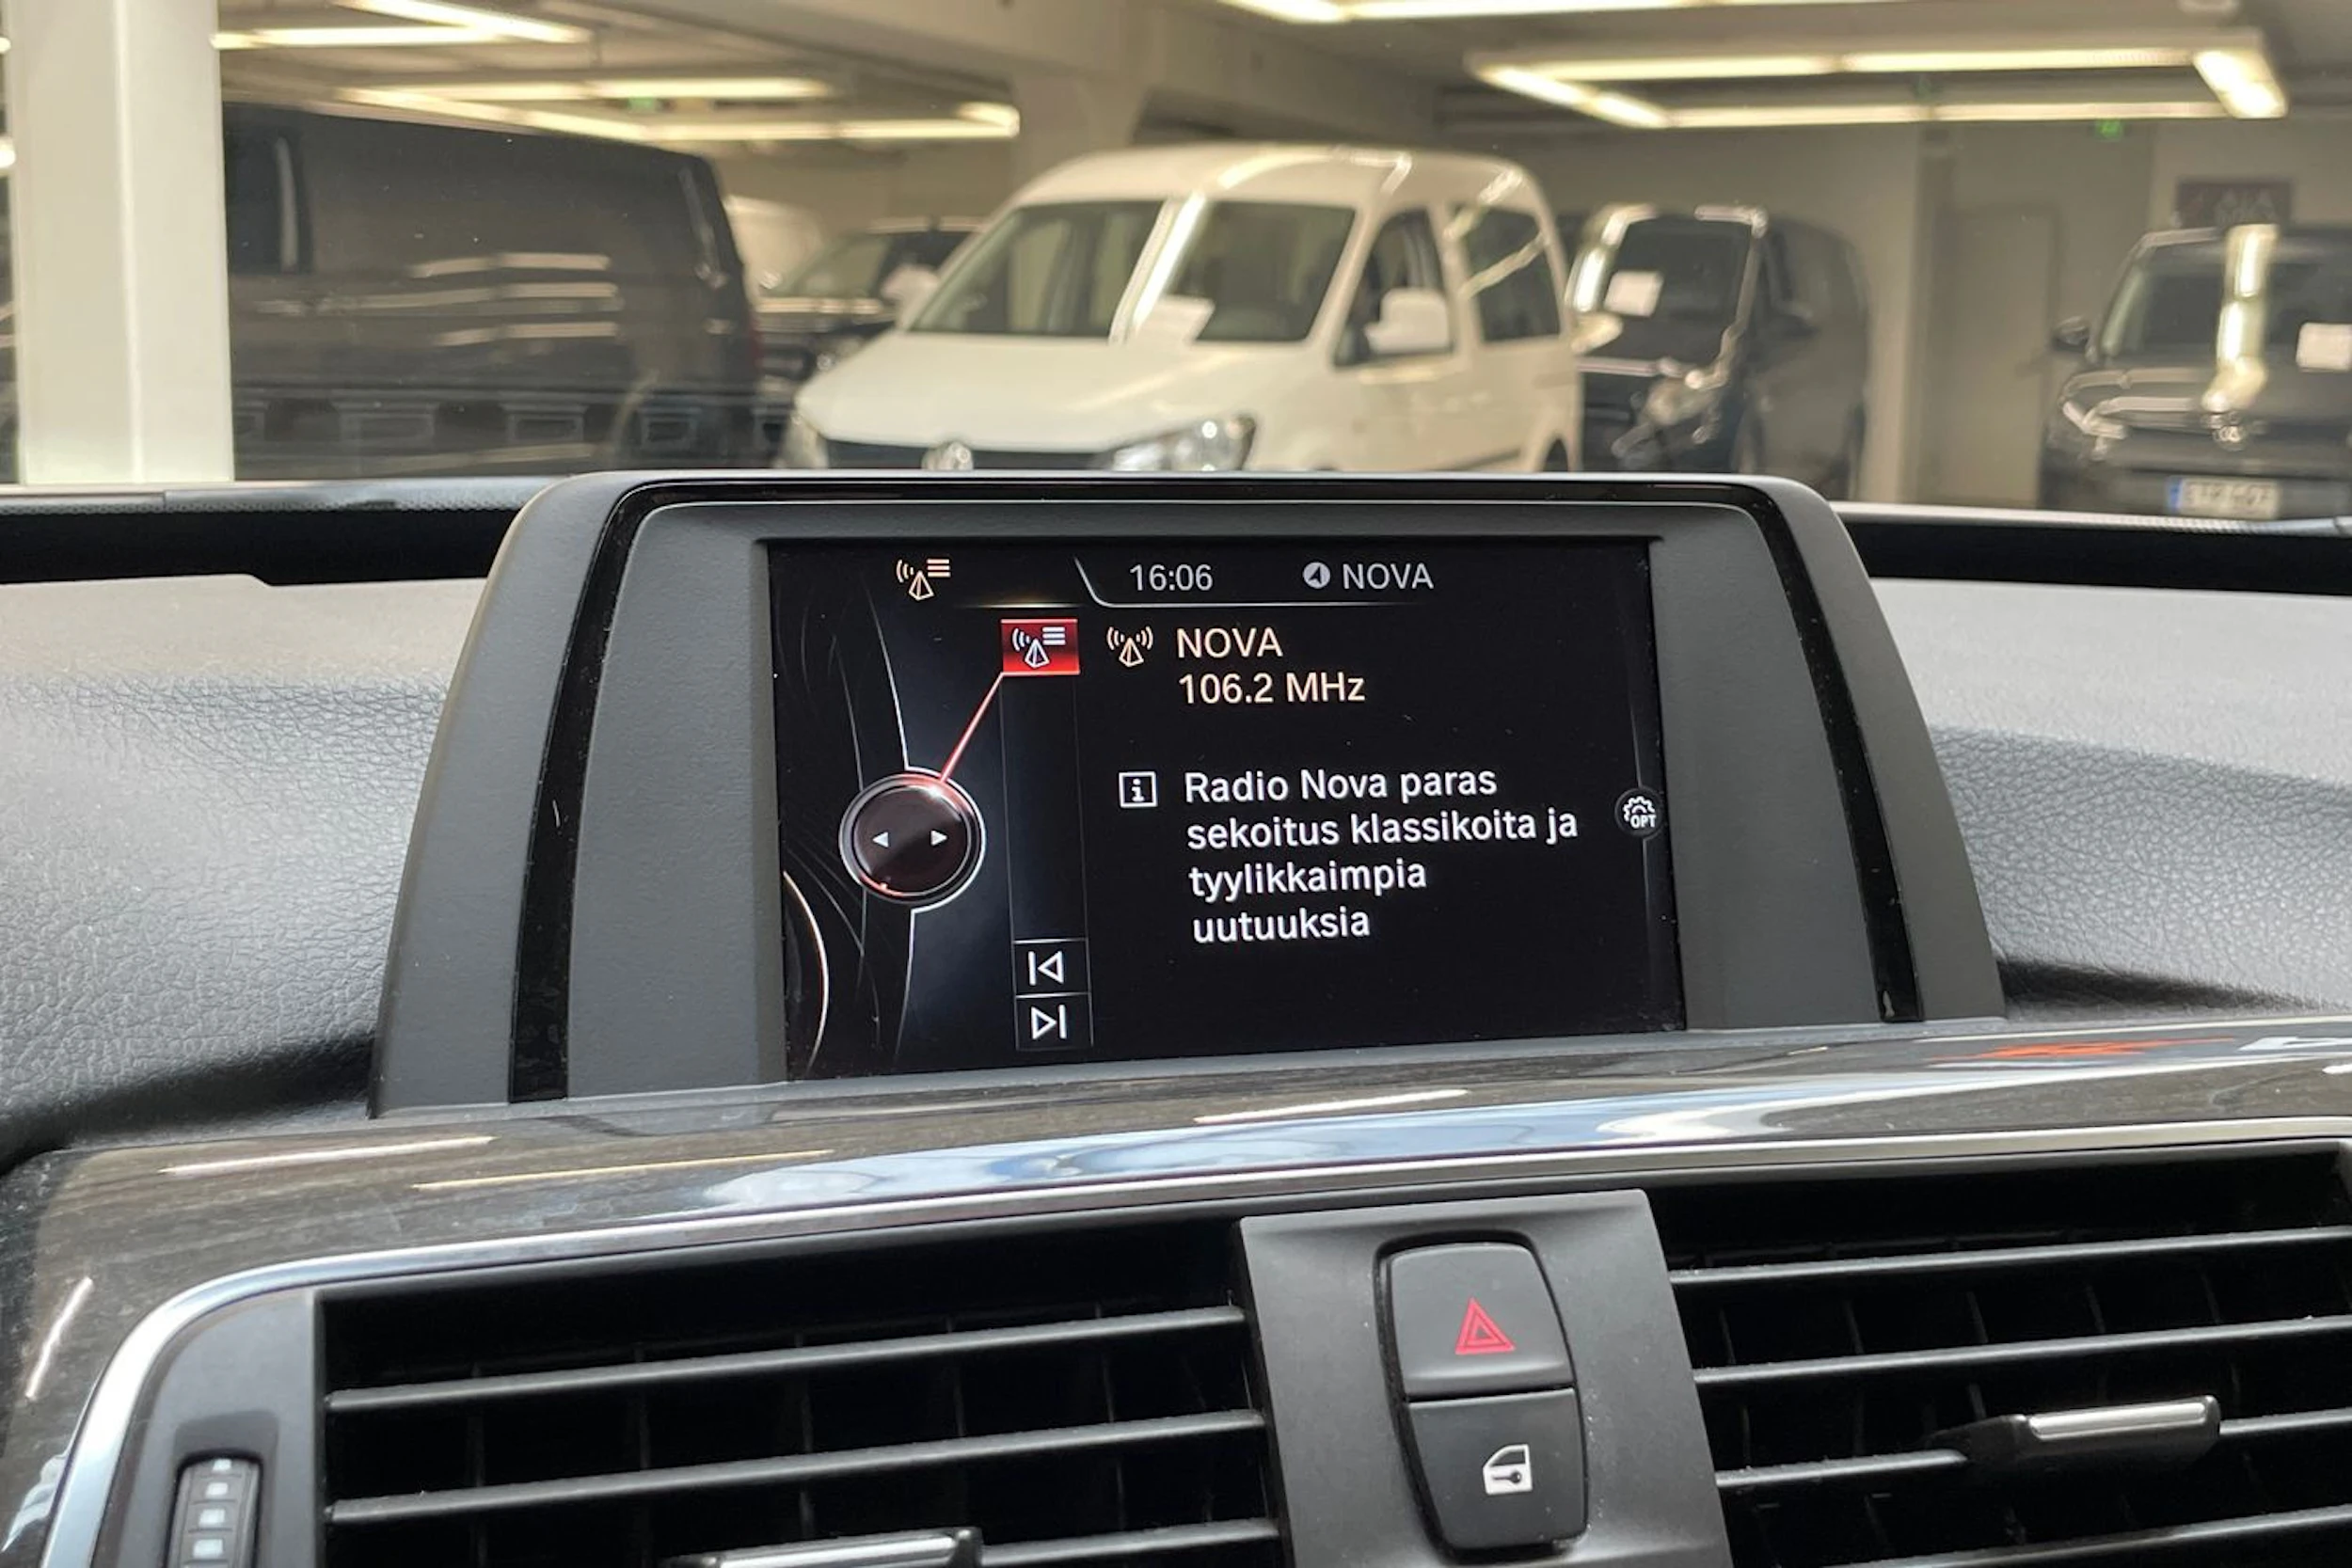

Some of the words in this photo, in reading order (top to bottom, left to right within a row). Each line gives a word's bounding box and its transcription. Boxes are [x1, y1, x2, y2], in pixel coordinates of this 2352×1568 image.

[1130, 563, 1213, 591] 16:06
[1343, 562, 1434, 590] NOVA
[1176, 626, 1283, 658] NOVA
[1178, 672, 1274, 705] 106.2
[1286, 672, 1366, 703] MHz
[1184, 771, 1289, 803] Radio
[1300, 768, 1388, 800] Nova
[1400, 770, 1500, 804] paras
[1187, 816, 1341, 850] sekoitus
[1350, 808, 1537, 845] klassikoita
[1546, 807, 1578, 846] ja
[1630, 814, 1657, 829] OPT
[1188, 858, 1427, 903] tyylikkaimpia
[1193, 906, 1371, 943] uutuuksia
